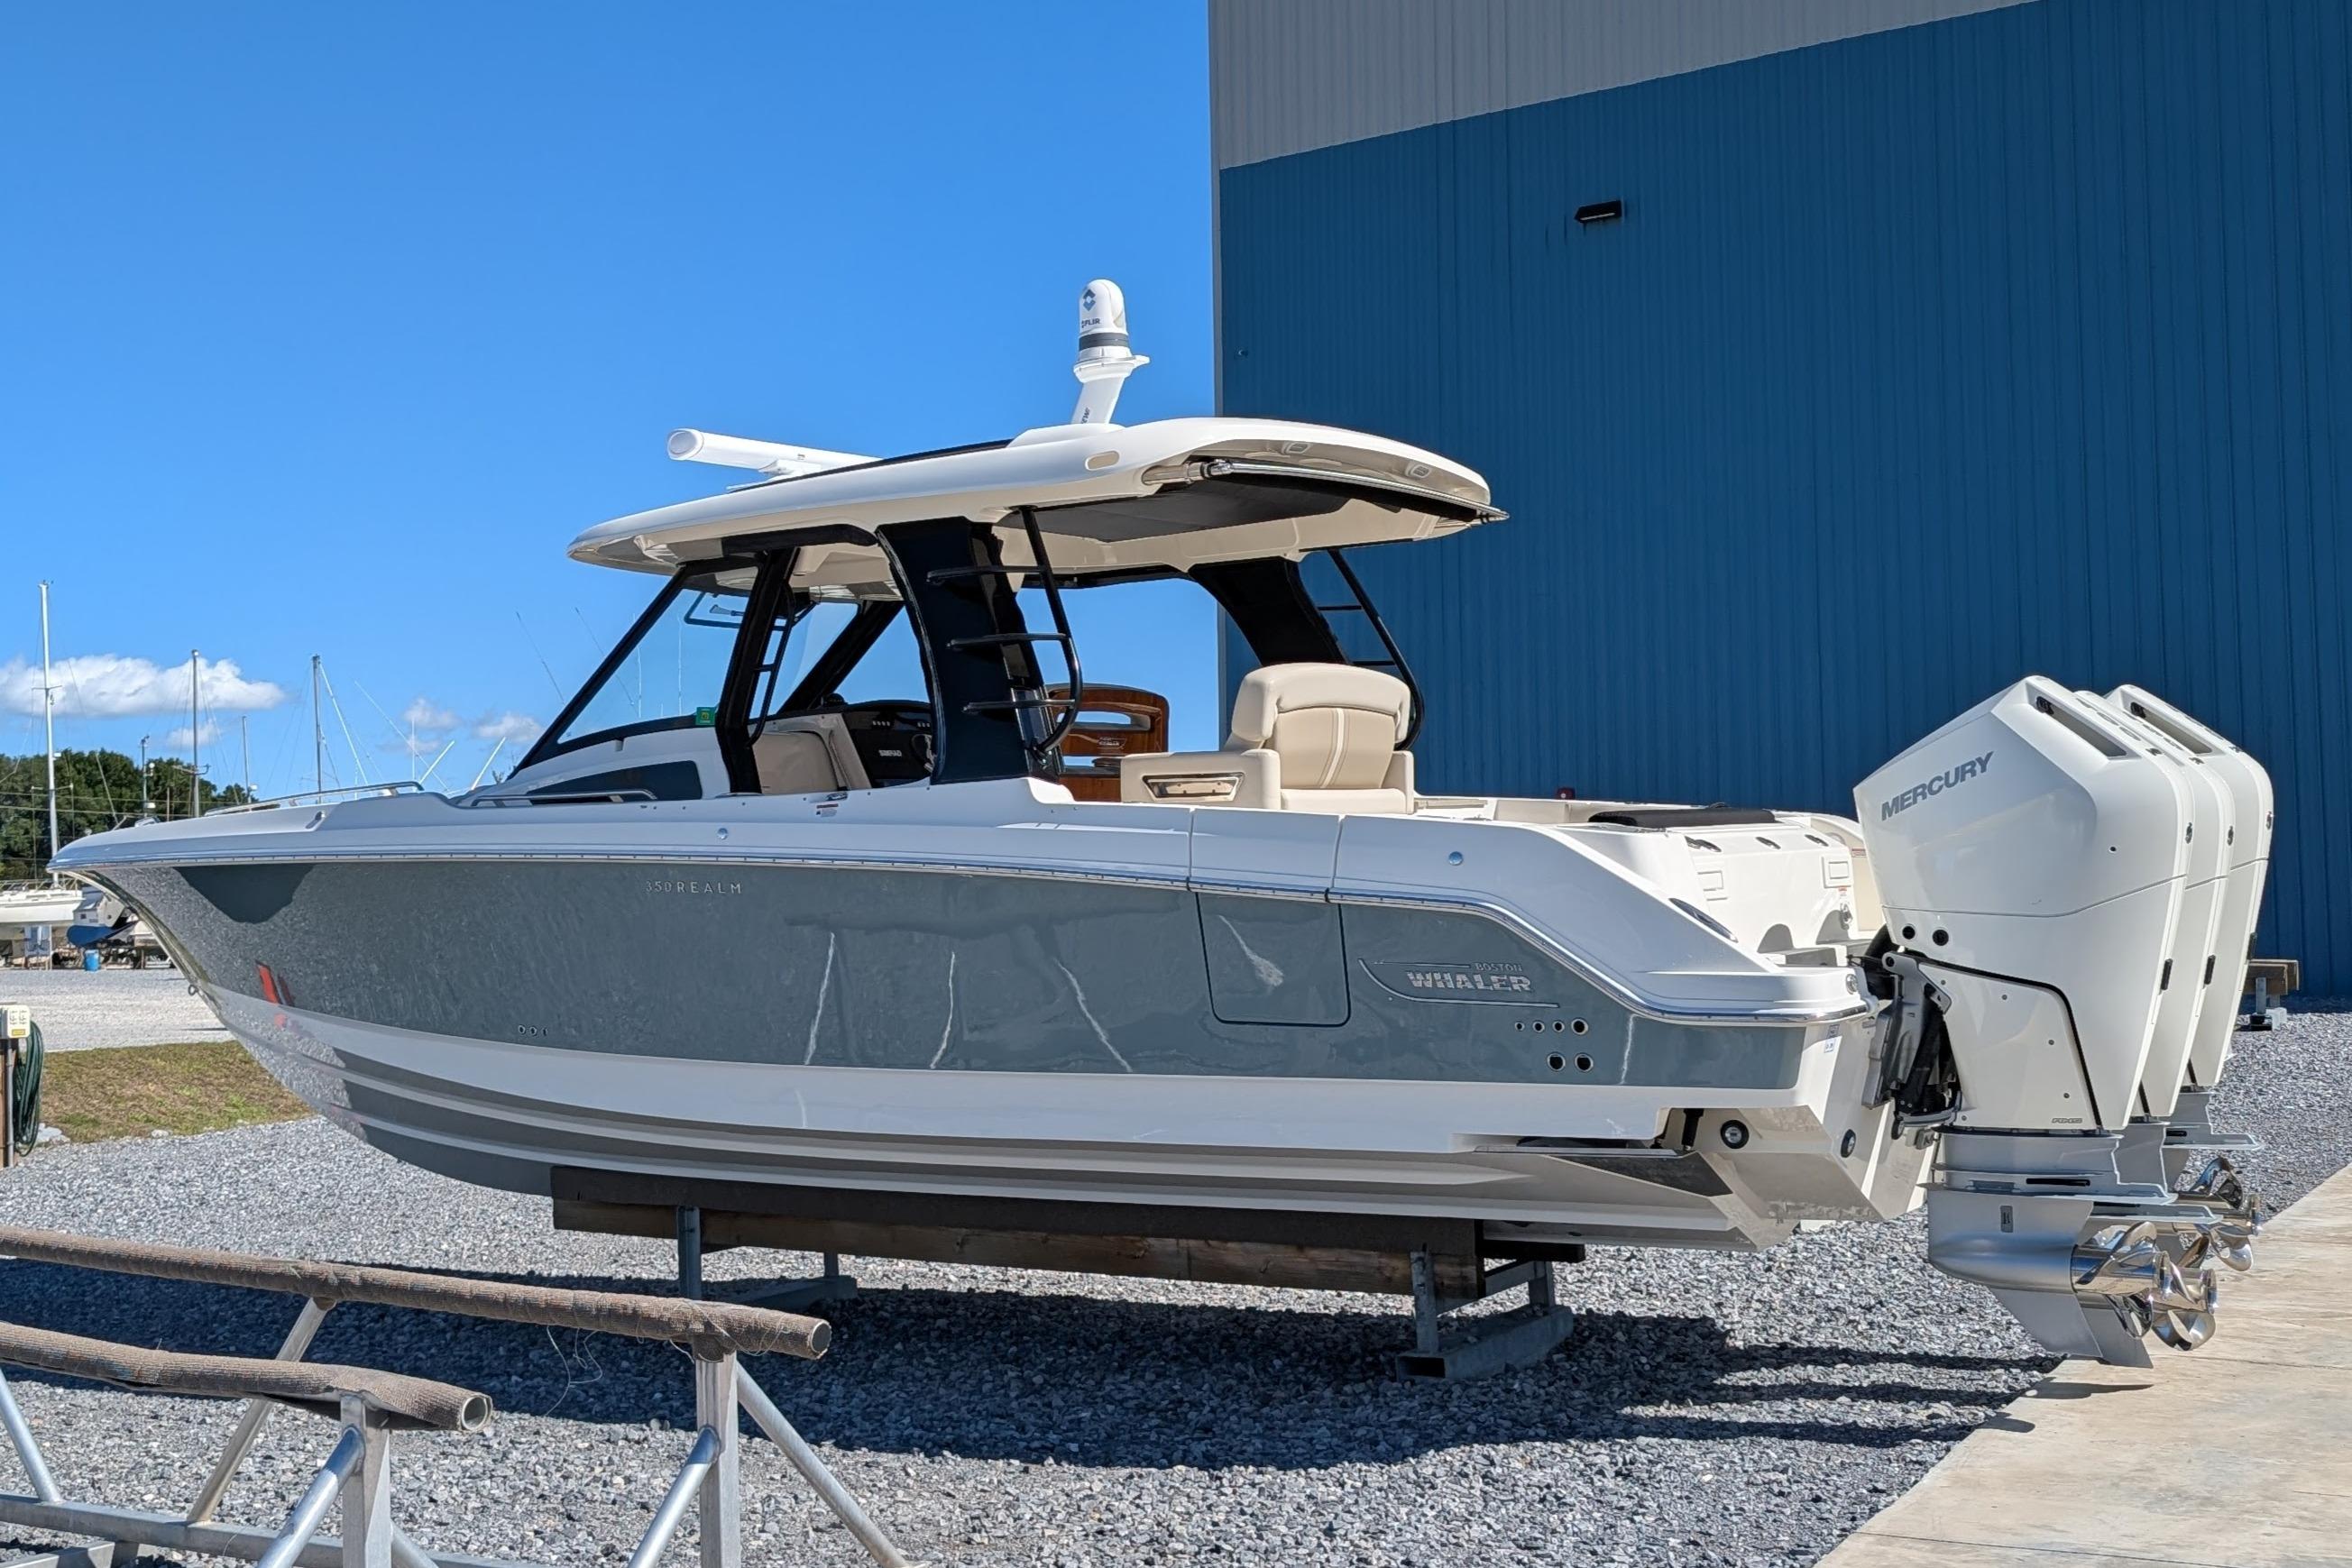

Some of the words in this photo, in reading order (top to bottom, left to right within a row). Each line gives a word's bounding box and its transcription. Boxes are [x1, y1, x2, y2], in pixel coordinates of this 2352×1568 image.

[1881, 751, 1994, 821] MERCURY
[1475, 962, 1523, 973] BOSTON
[1407, 971, 1532, 992] WHALER
